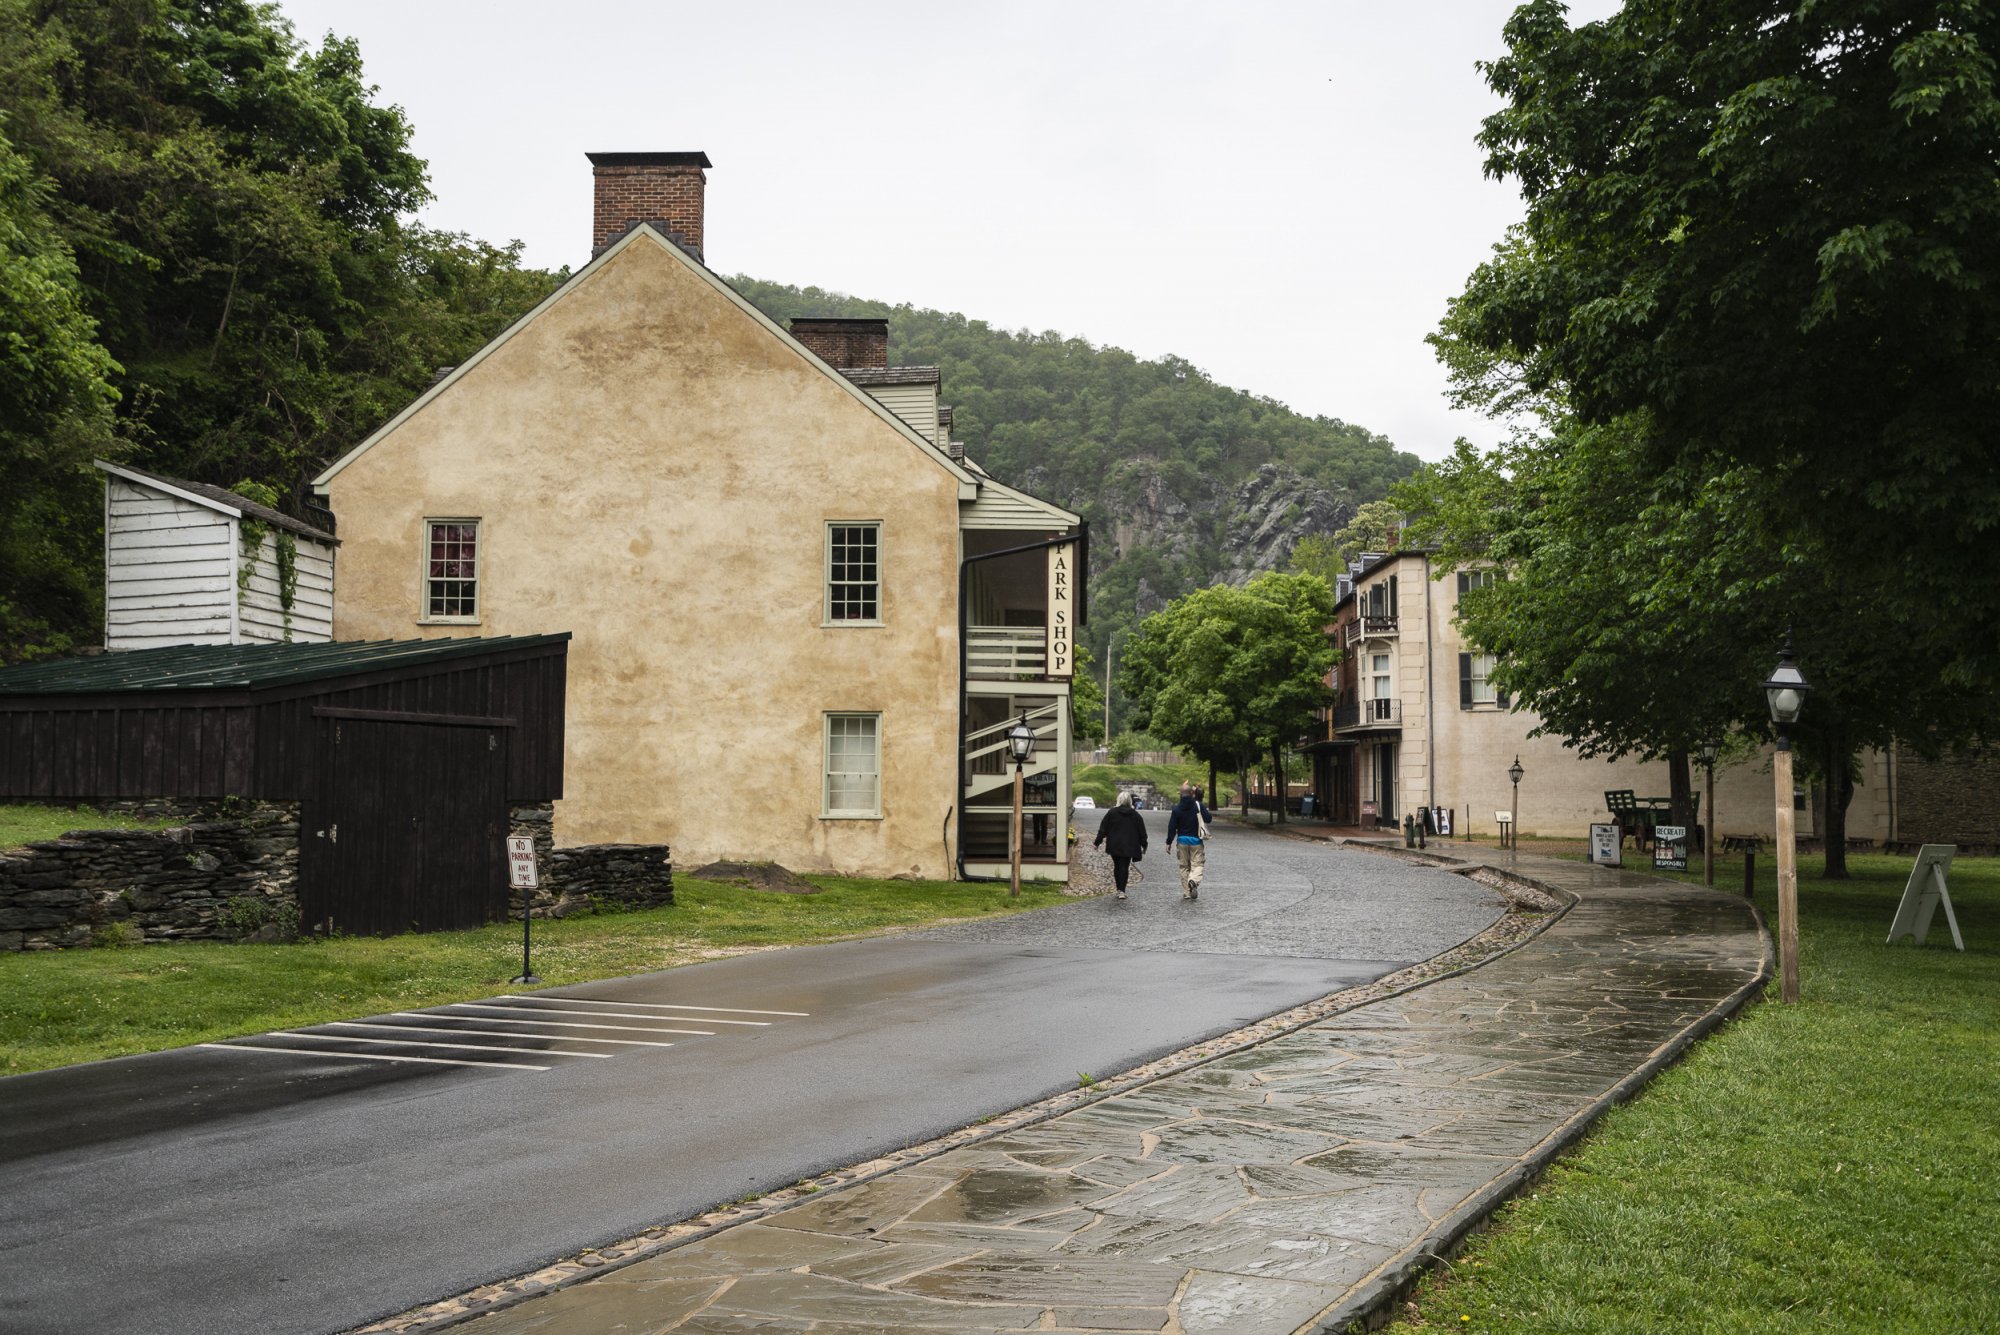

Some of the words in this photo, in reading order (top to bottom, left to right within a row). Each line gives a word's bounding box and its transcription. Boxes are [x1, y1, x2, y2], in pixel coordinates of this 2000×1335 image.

[1054, 543, 1067, 600] PARK
[1053, 610, 1067, 670] SHOP
[1656, 828, 1685, 836] RECREATE
[515, 841, 525, 850] NO
[511, 852, 532, 861] PARKING
[518, 864, 529, 872] ANY
[518, 873, 531, 882] TIME
